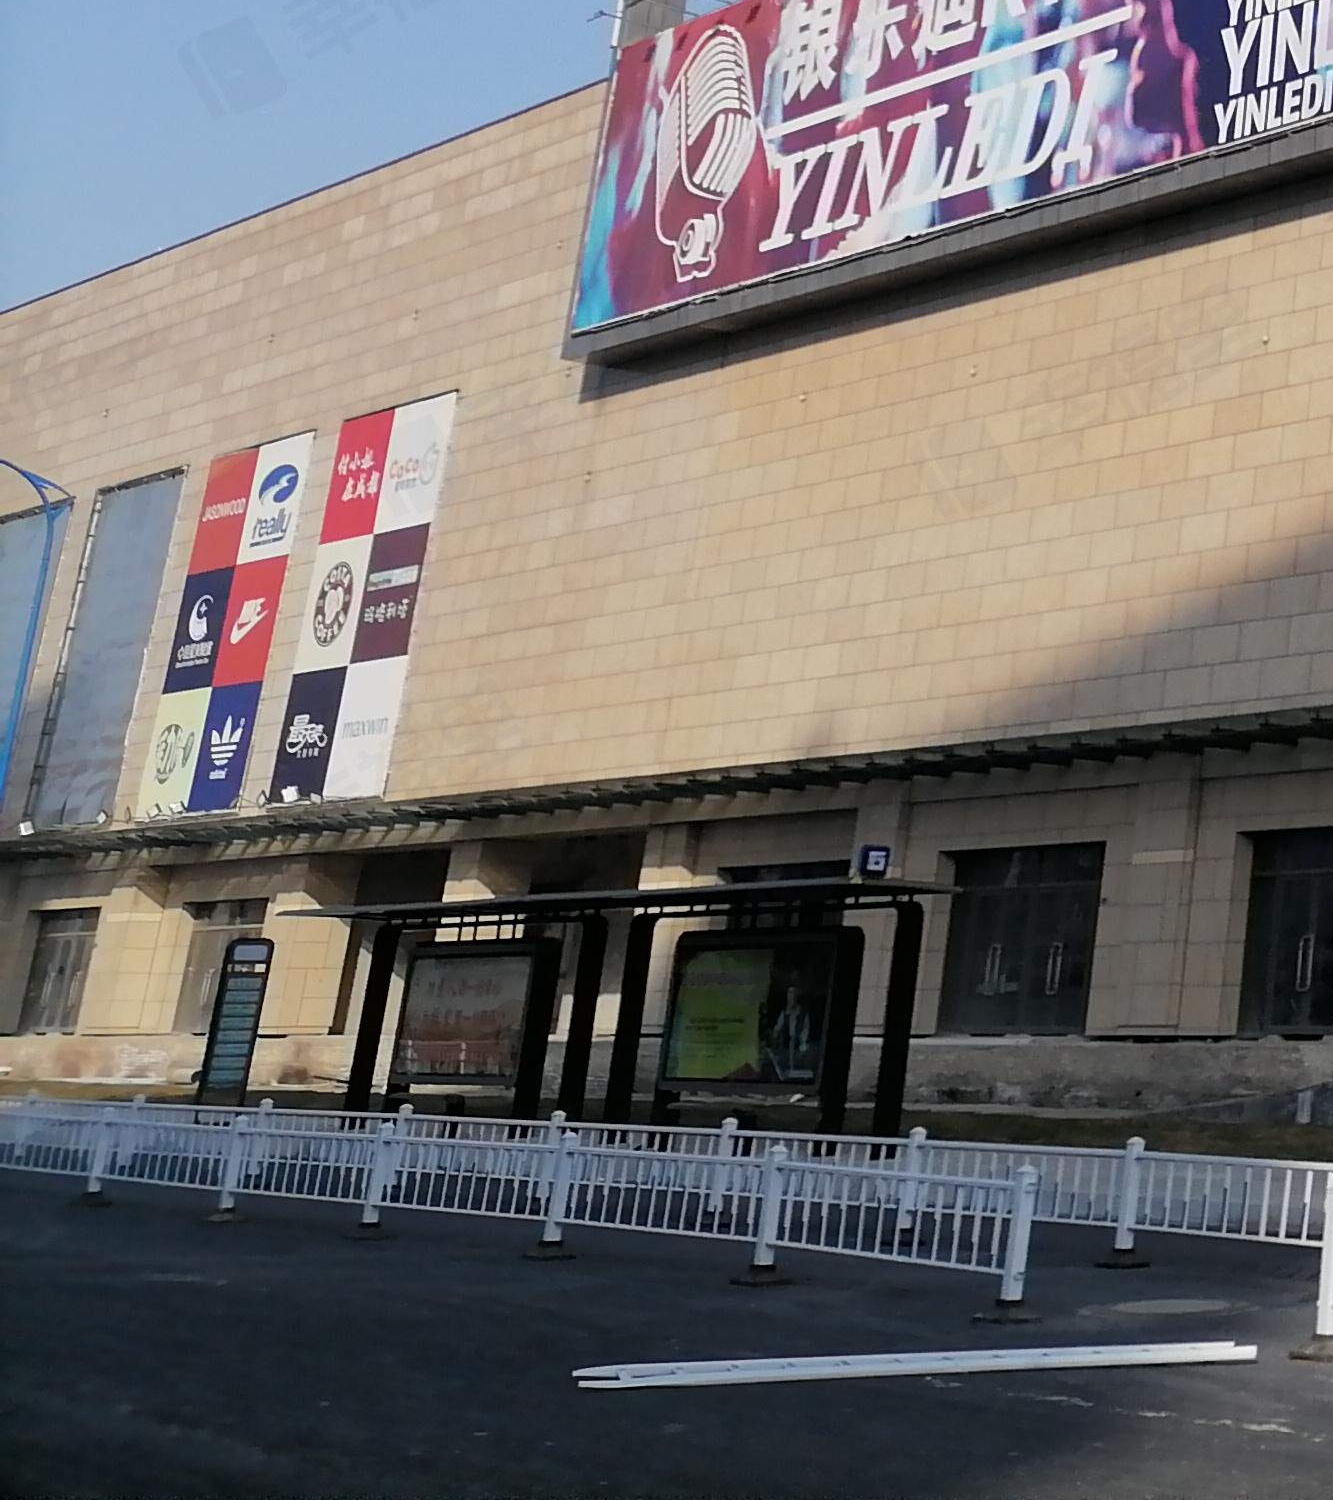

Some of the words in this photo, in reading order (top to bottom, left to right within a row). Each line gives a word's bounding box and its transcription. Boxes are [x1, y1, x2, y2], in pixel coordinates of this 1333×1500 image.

[1214, 74, 1332, 143] YINLEDI
[759, 49, 1117, 252] YINLEDI
[202, 498, 246, 522] JASONWOOD
[252, 508, 292, 539] really
[342, 718, 389, 739] maxwin
